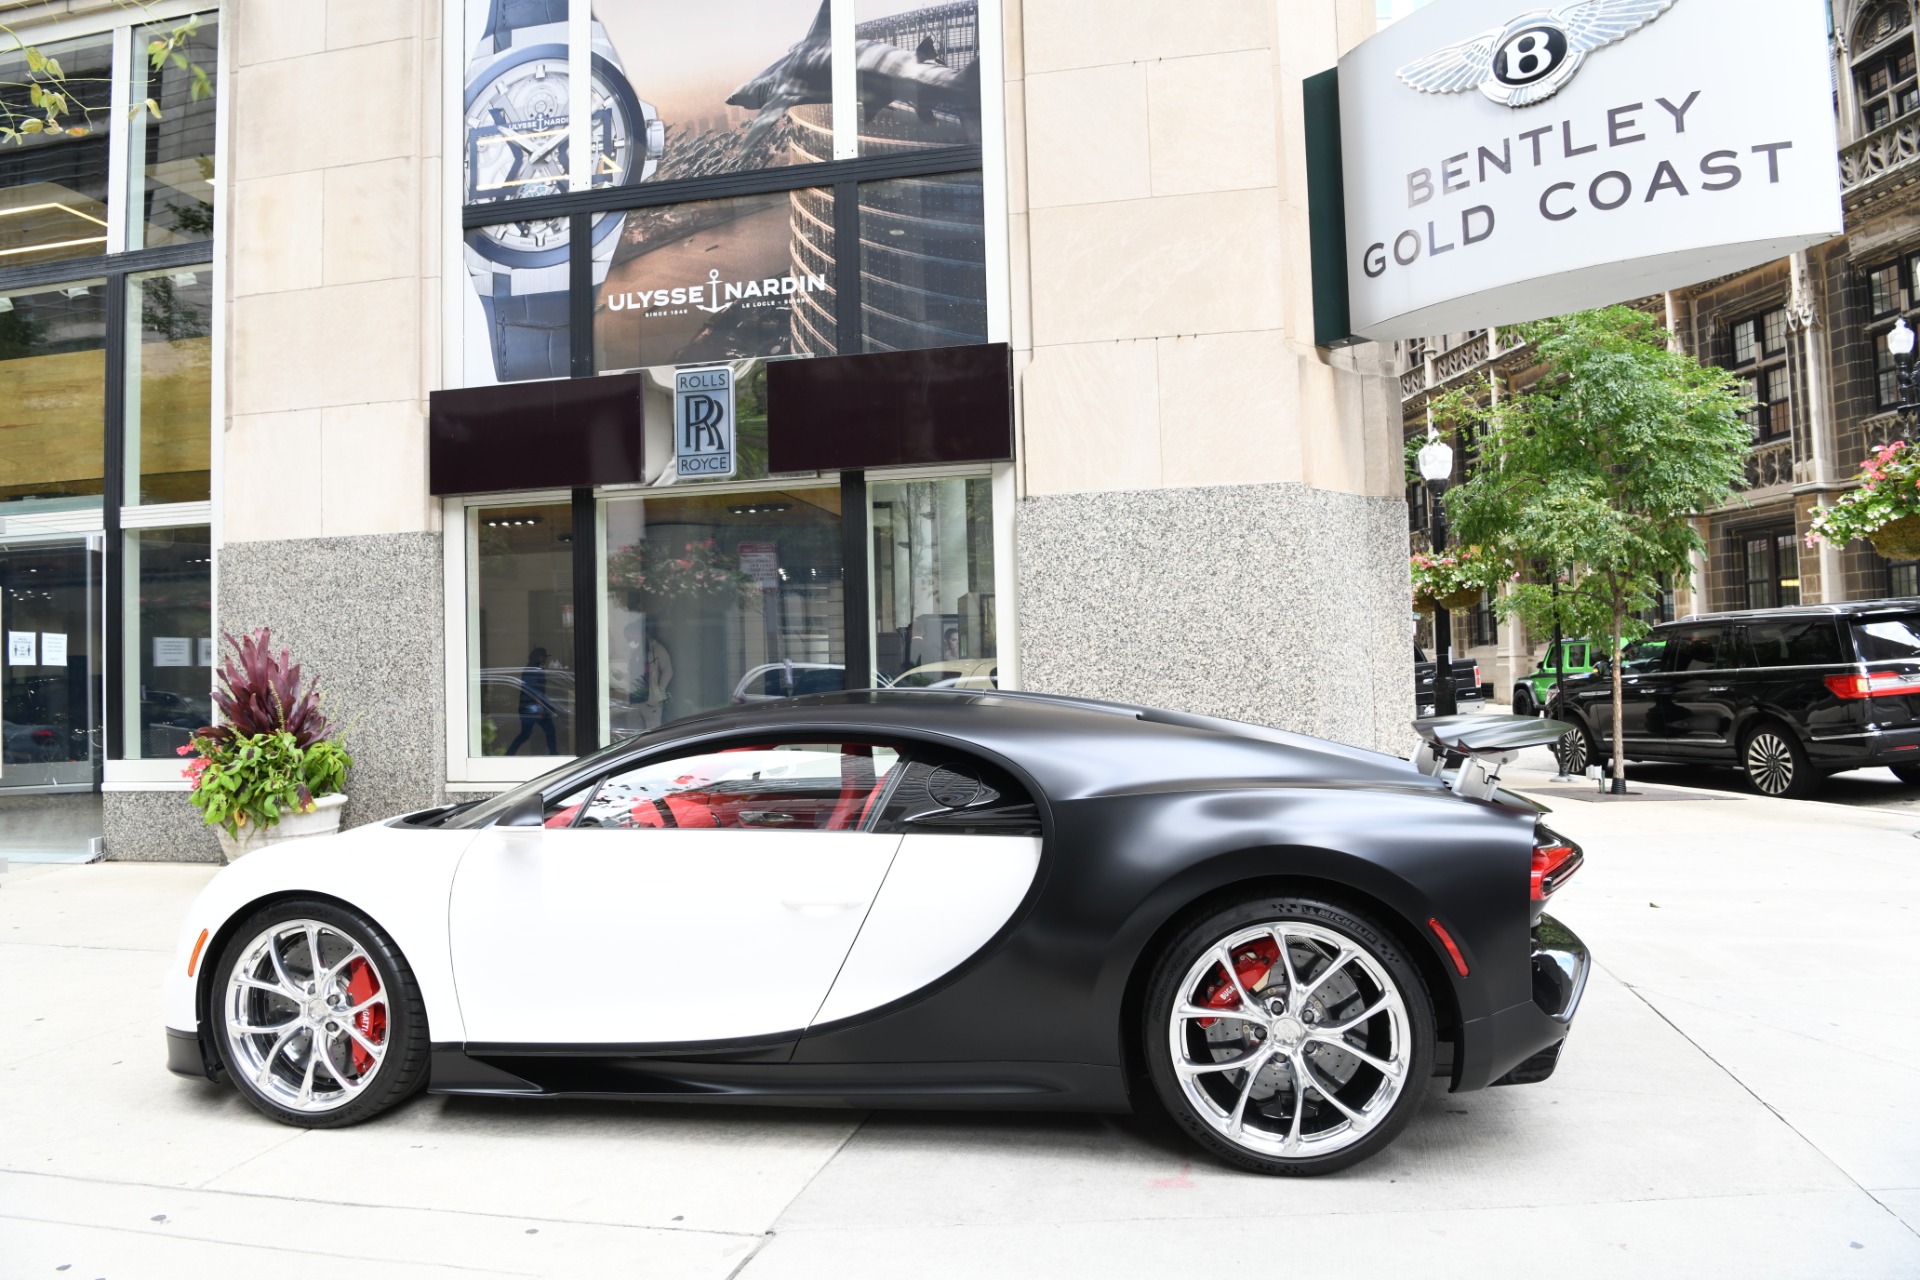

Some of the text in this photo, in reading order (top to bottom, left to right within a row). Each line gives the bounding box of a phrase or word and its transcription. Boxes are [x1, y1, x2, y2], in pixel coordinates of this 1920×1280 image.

[1504, 31, 1552, 80] B
[543, 117, 569, 126] NARDI
[1407, 90, 1701, 208] BENTLEY
[1363, 141, 1793, 278] GOLD COAST
[608, 274, 825, 311] ULYSSE NARDIN
[680, 374, 726, 389] ROLLS
[681, 457, 727, 471] ROYCE
[1319, 909, 1378, 945] MICHELIN
[1220, 984, 1237, 1000] BUGA
